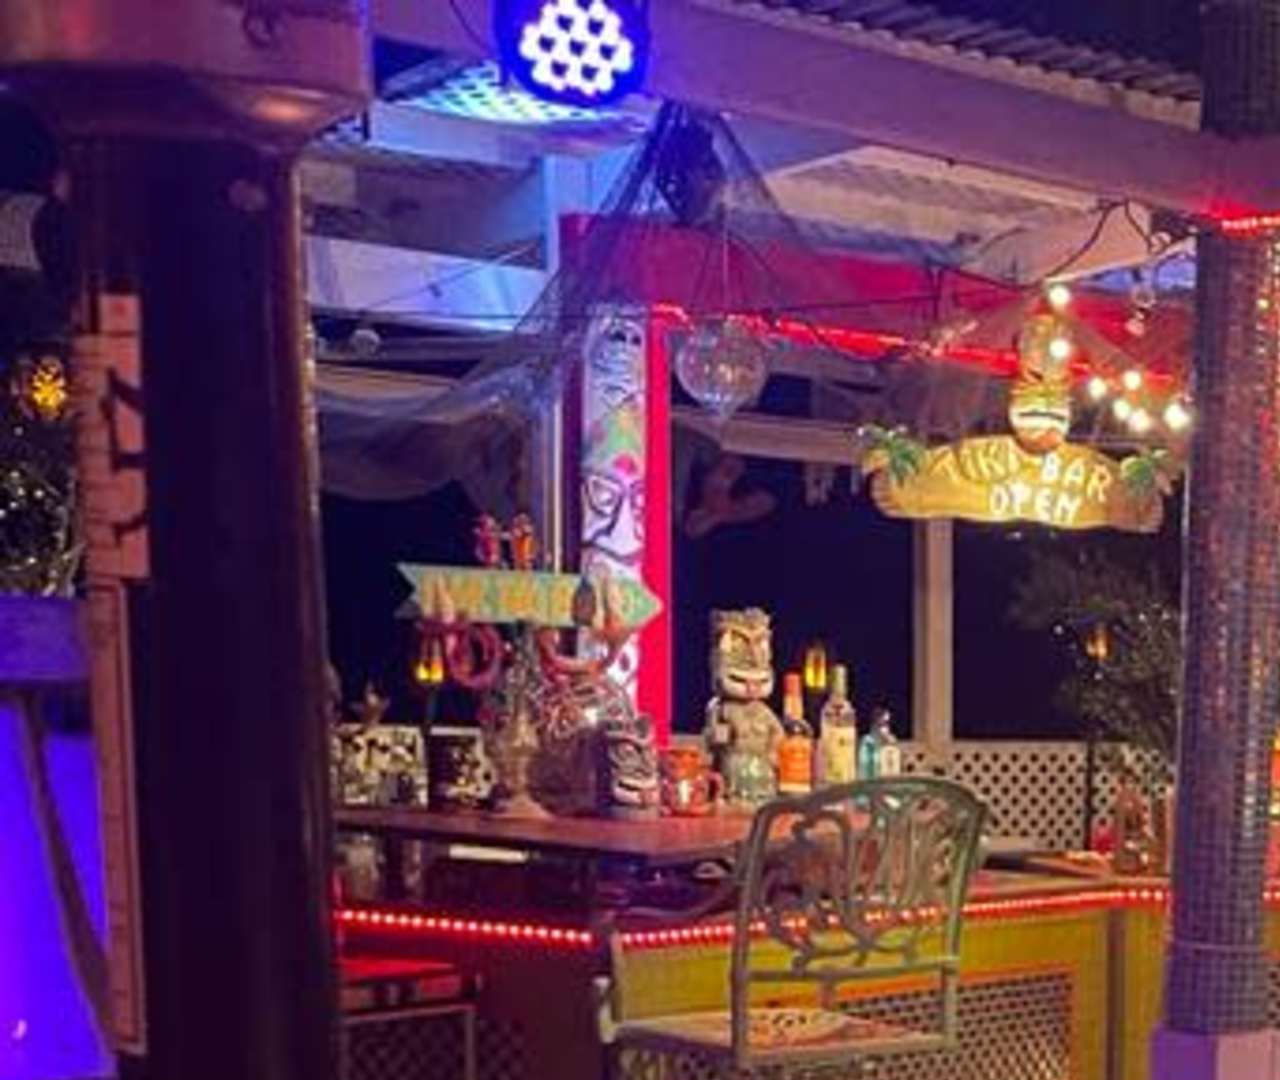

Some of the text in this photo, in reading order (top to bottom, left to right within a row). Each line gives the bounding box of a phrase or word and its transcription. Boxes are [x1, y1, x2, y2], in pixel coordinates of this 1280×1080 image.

[930, 443, 1111, 502] TIKI BAR
[989, 480, 1082, 524] OPEN
